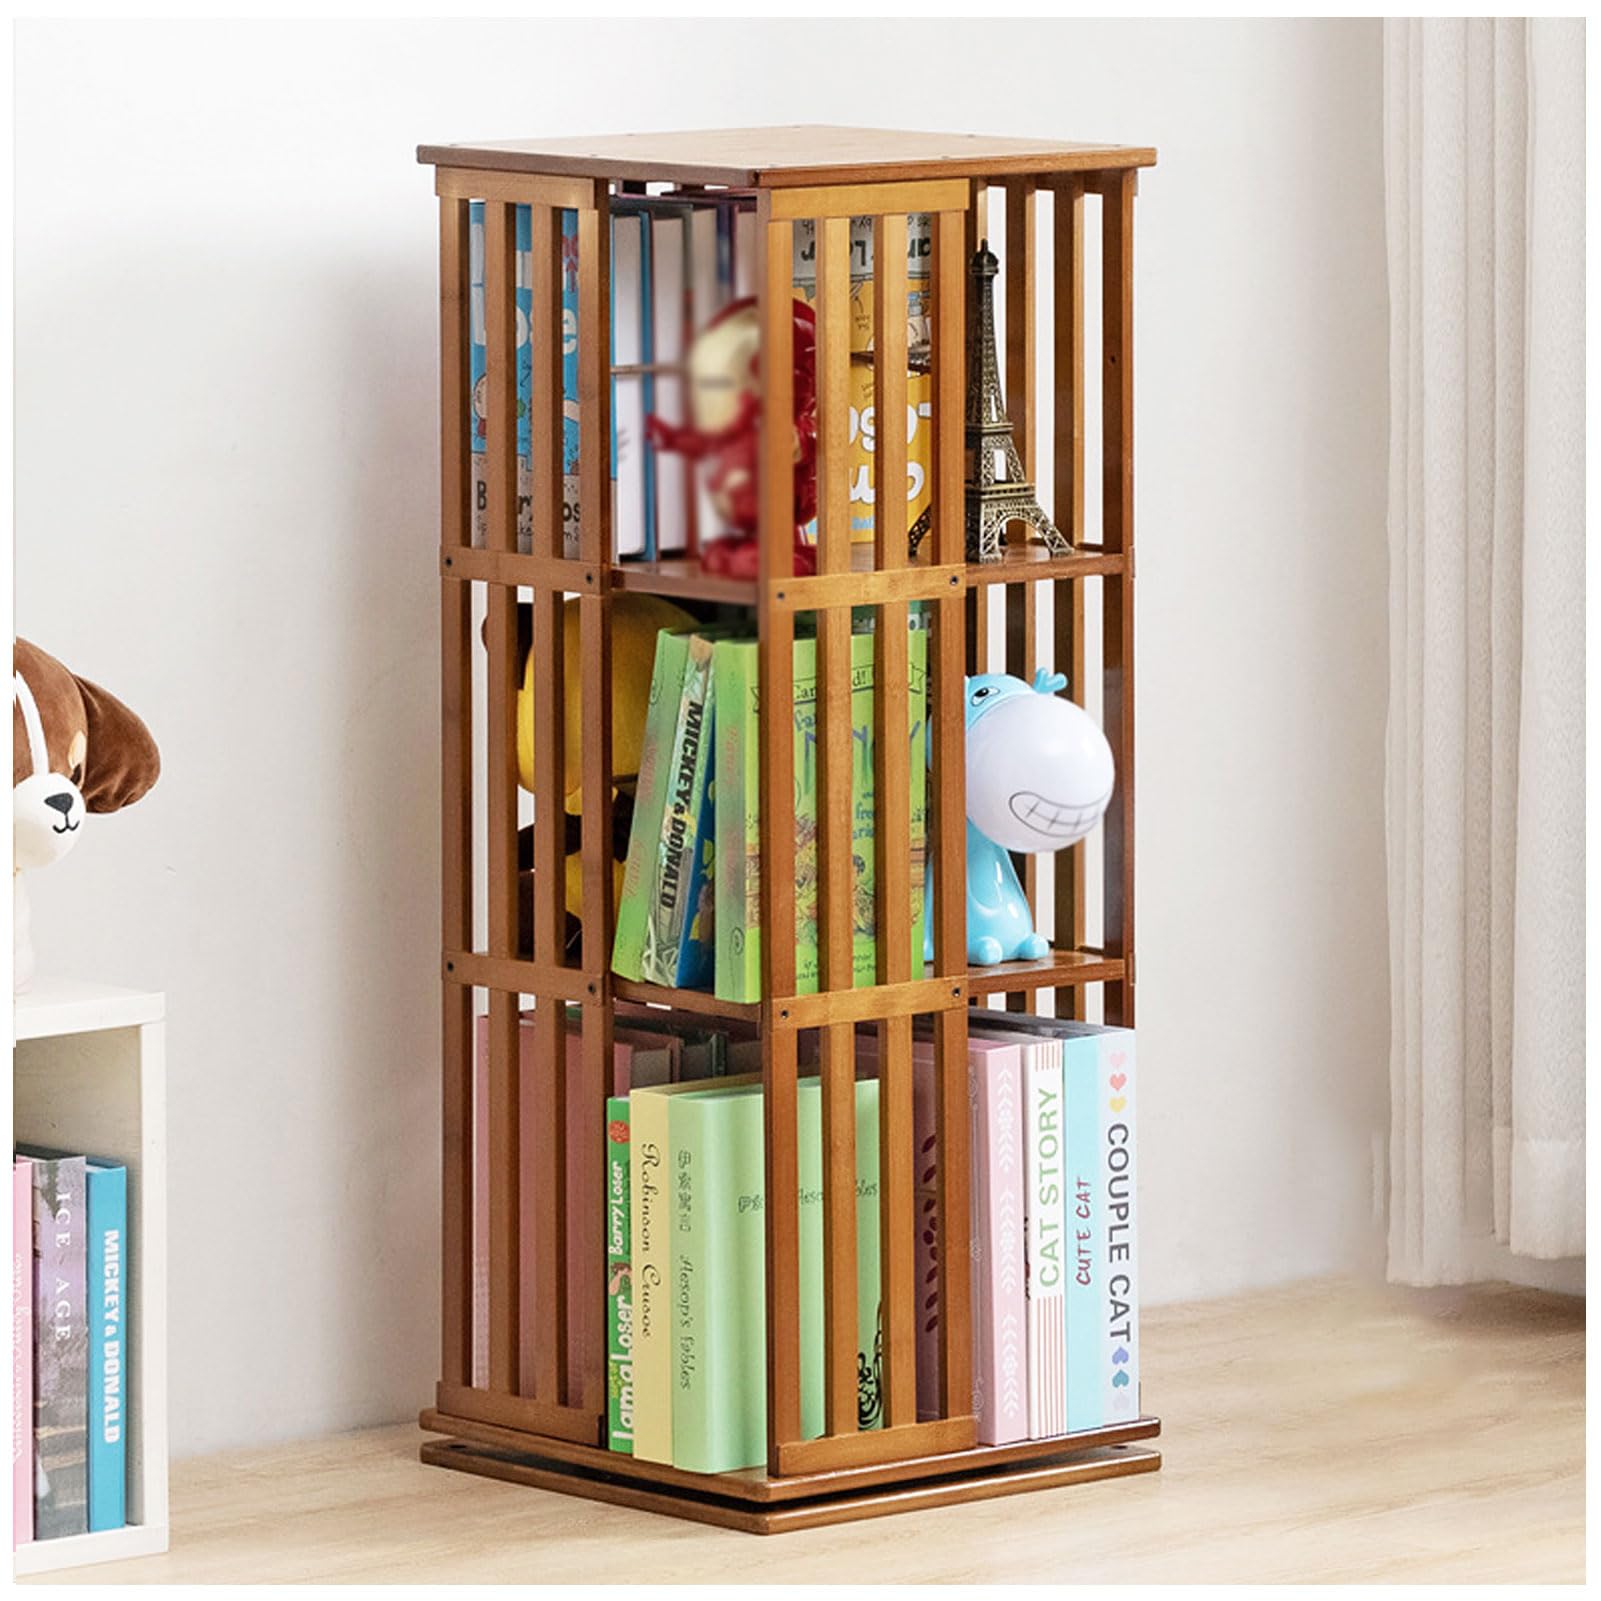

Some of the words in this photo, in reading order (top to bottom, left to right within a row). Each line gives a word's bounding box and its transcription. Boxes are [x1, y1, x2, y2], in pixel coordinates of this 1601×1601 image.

[675, 701, 703, 807] MICKEY
[661, 815, 687, 909] DONALD
[1038, 1088, 1058, 1206] STORY
[611, 1161, 624, 1204] Loser
[642, 1144, 661, 1252] Robinson
[1075, 1176, 1091, 1219] CAT
[1108, 1123, 1129, 1263] COUPLE
[55, 1193, 71, 1248] ICE
[608, 1206, 625, 1255] Barry
[1039, 1218, 1059, 1287] CAT
[104, 1229, 120, 1322] MICKEY
[1075, 1228, 1092, 1285] CUTE
[55, 1278, 71, 1340] AGE
[610, 1295, 632, 1361] Loser
[642, 1264, 661, 1338] Crusoe
[1109, 1274, 1131, 1342] CAT
[103, 1340, 120, 1443] DONALD
